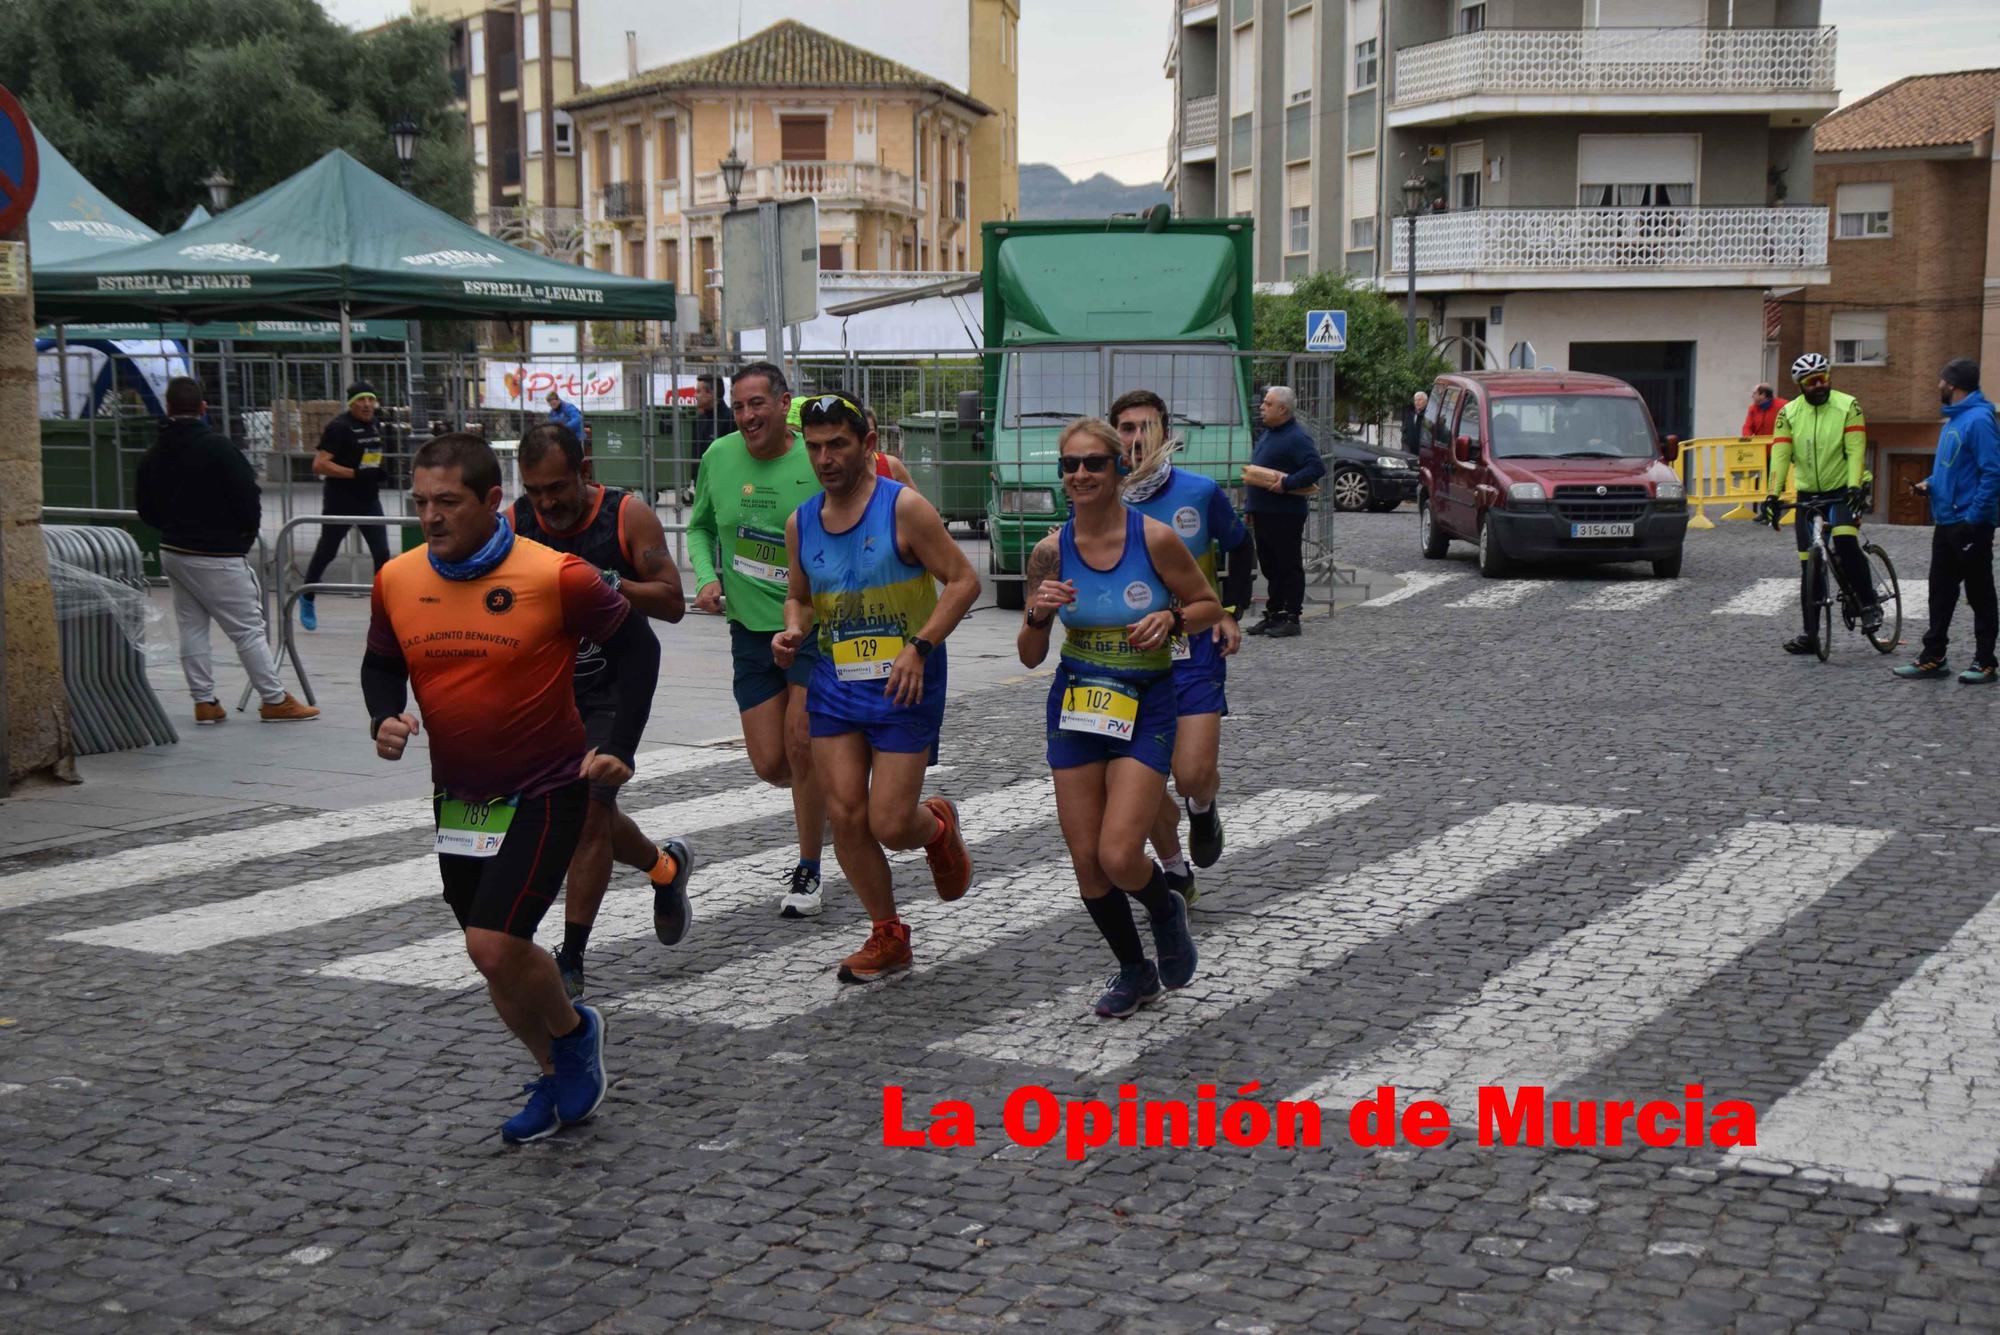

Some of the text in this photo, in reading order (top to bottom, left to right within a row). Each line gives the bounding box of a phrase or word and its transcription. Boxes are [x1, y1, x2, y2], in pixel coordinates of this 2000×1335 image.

[97, 276, 171, 290] ESTRELLA
[183, 275, 252, 289] LEVANTE
[463, 280, 534, 298] ESTRELLA
[545, 286, 604, 303] LEVANTE
[257, 320, 312, 332] ESTRELLA
[1580, 524, 1631, 536] 3154 CNX
[756, 543, 776, 561] 701
[424, 631, 463, 642] JACINTO
[465, 631, 520, 649] BENAVENTE
[854, 639, 877, 657] 129
[424, 649, 488, 658] ALCANTARILLA
[1087, 689, 1112, 710] 102
[462, 803, 490, 826] 789
